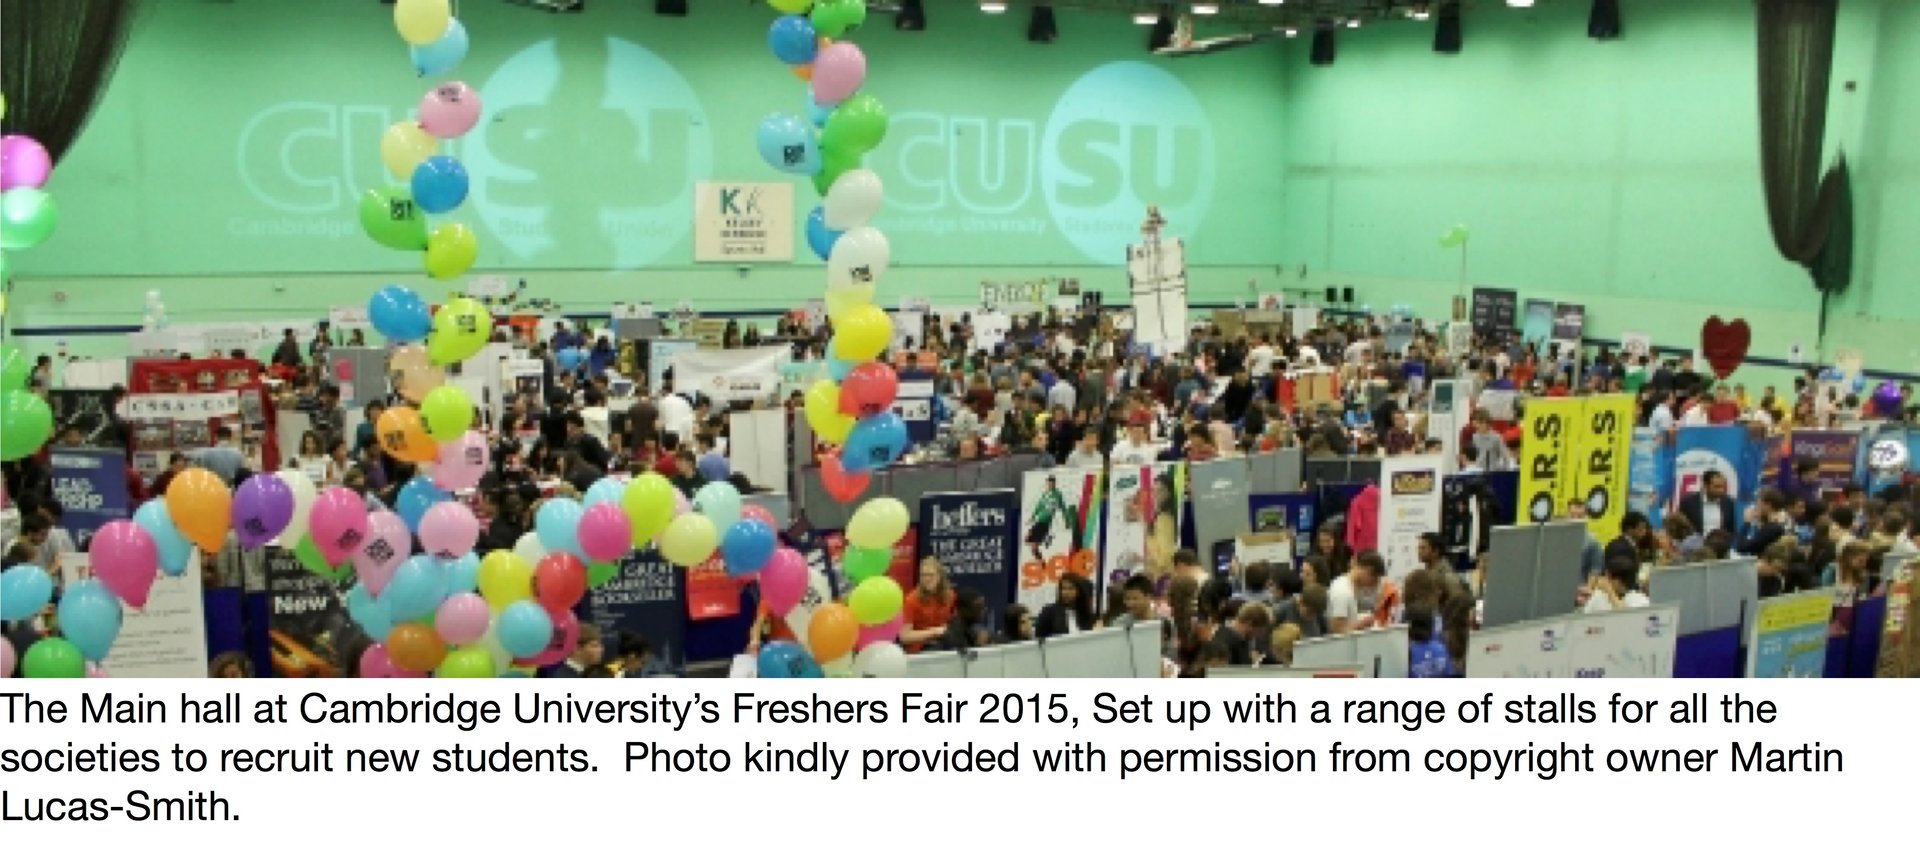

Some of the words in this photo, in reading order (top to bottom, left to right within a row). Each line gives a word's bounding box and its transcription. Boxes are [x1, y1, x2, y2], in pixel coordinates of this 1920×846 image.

[866, 111, 1203, 214] CUSU
[226, 216, 356, 241] Cambridge
[931, 501, 1005, 531] heffers
[274, 595, 327, 615] New
